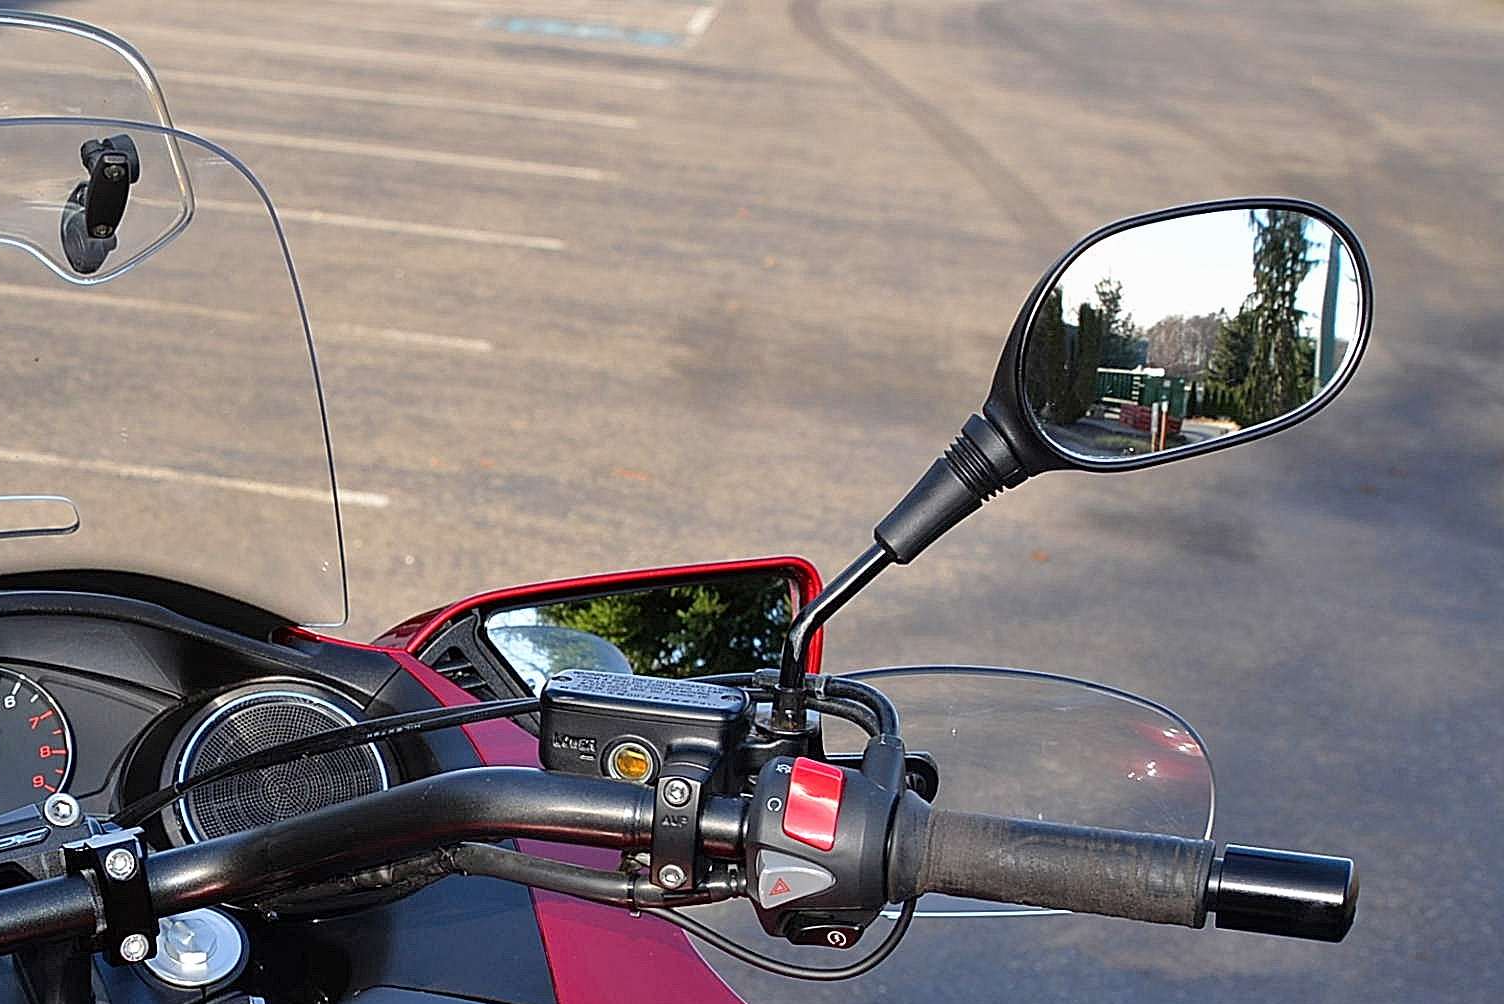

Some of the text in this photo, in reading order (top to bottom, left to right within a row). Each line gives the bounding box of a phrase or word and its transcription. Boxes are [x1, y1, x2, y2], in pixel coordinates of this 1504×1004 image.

[4, 696, 16, 708] 6
[28, 717, 41, 729] 7
[39, 746, 52, 758] 8
[32, 775, 45, 788] 9
